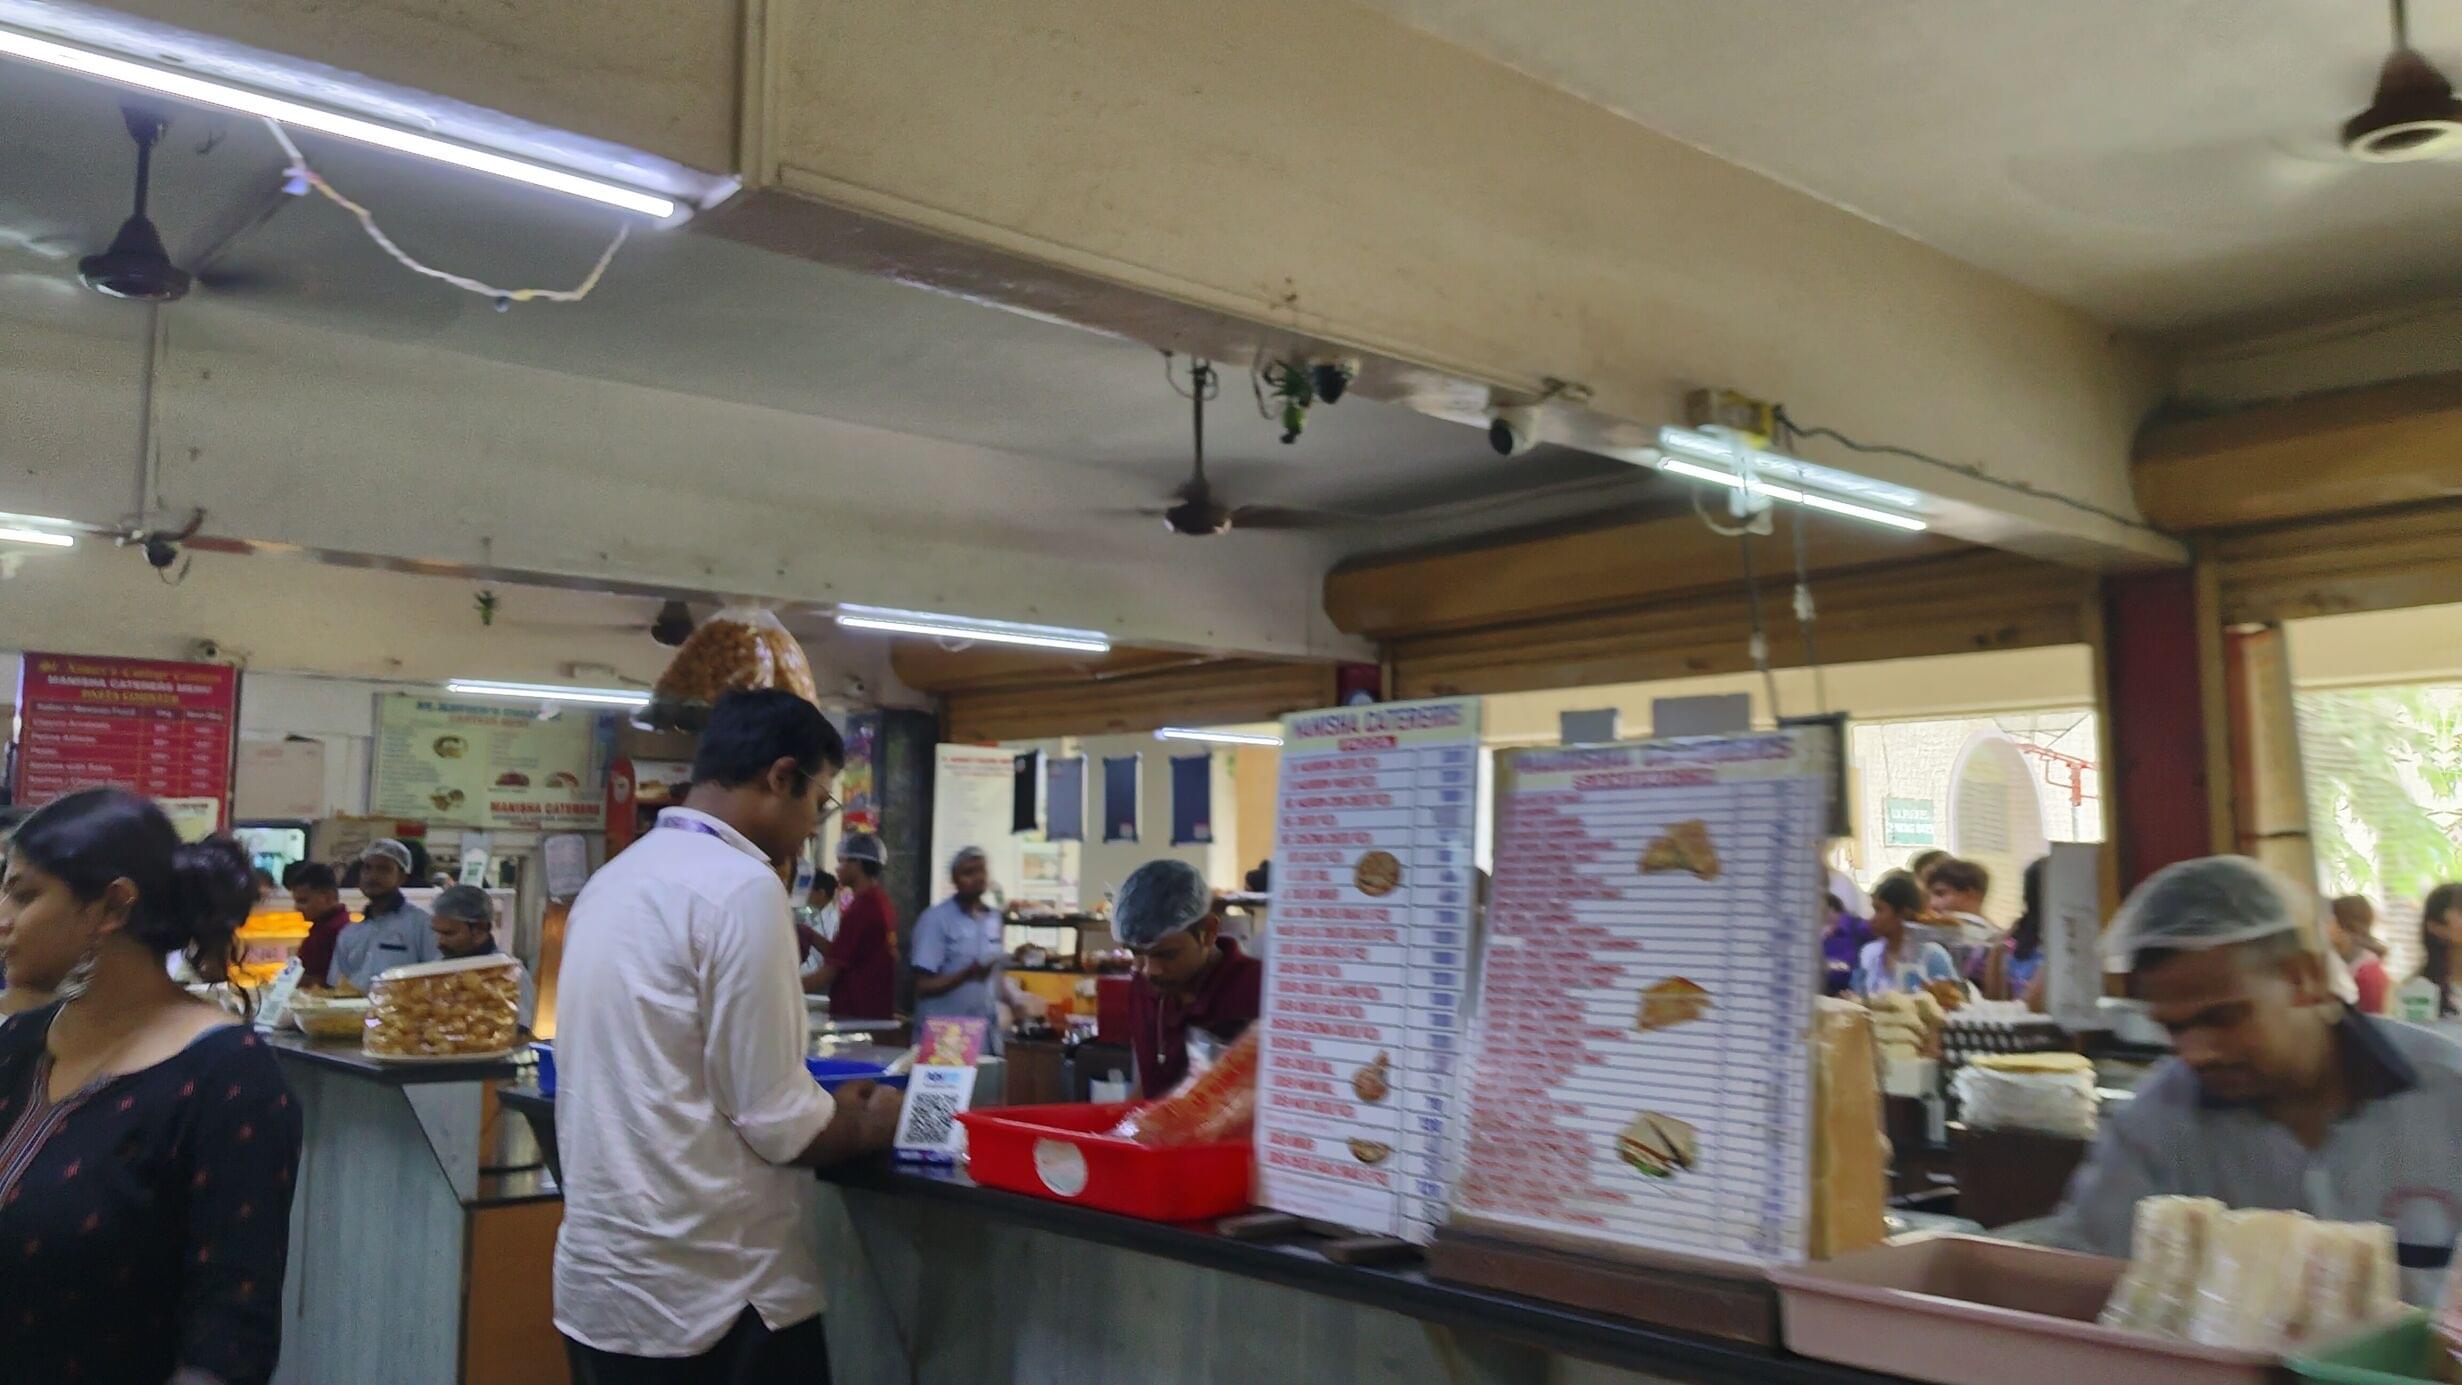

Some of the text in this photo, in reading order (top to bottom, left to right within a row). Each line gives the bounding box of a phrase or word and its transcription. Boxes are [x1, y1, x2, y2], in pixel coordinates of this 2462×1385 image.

[47, 675, 106, 688] MANISHA
[109, 678, 173, 692] CATERERS
[1295, 703, 1462, 739] MANISHA CATERERS
[490, 800, 601, 815] MANISHA CATERERS
